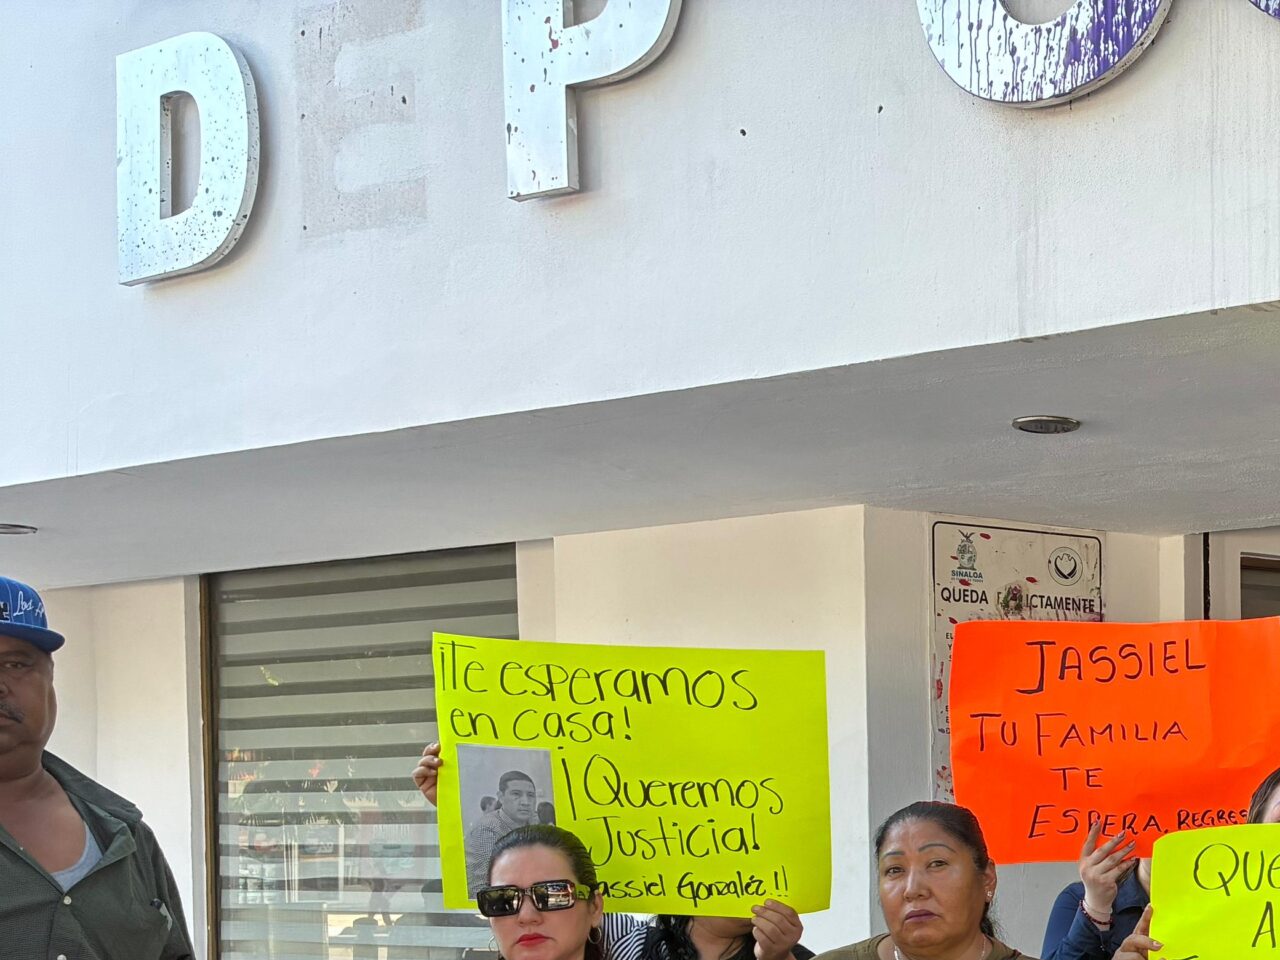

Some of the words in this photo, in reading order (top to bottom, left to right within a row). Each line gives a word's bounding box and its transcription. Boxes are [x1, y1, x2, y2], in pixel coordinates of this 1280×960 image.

[951, 569, 983, 579] SINALOA
[941, 587, 989, 605] QUEDA
[1014, 638, 1207, 695] JASSIEL
[450, 706, 499, 740] en
[513, 705, 633, 743] casa!
[969, 711, 1018, 752] TU
[1034, 712, 1189, 757] FAMILIA
[1049, 766, 1104, 792] TE
[585, 813, 761, 869] Justicia!
[598, 873, 667, 899] assiel
